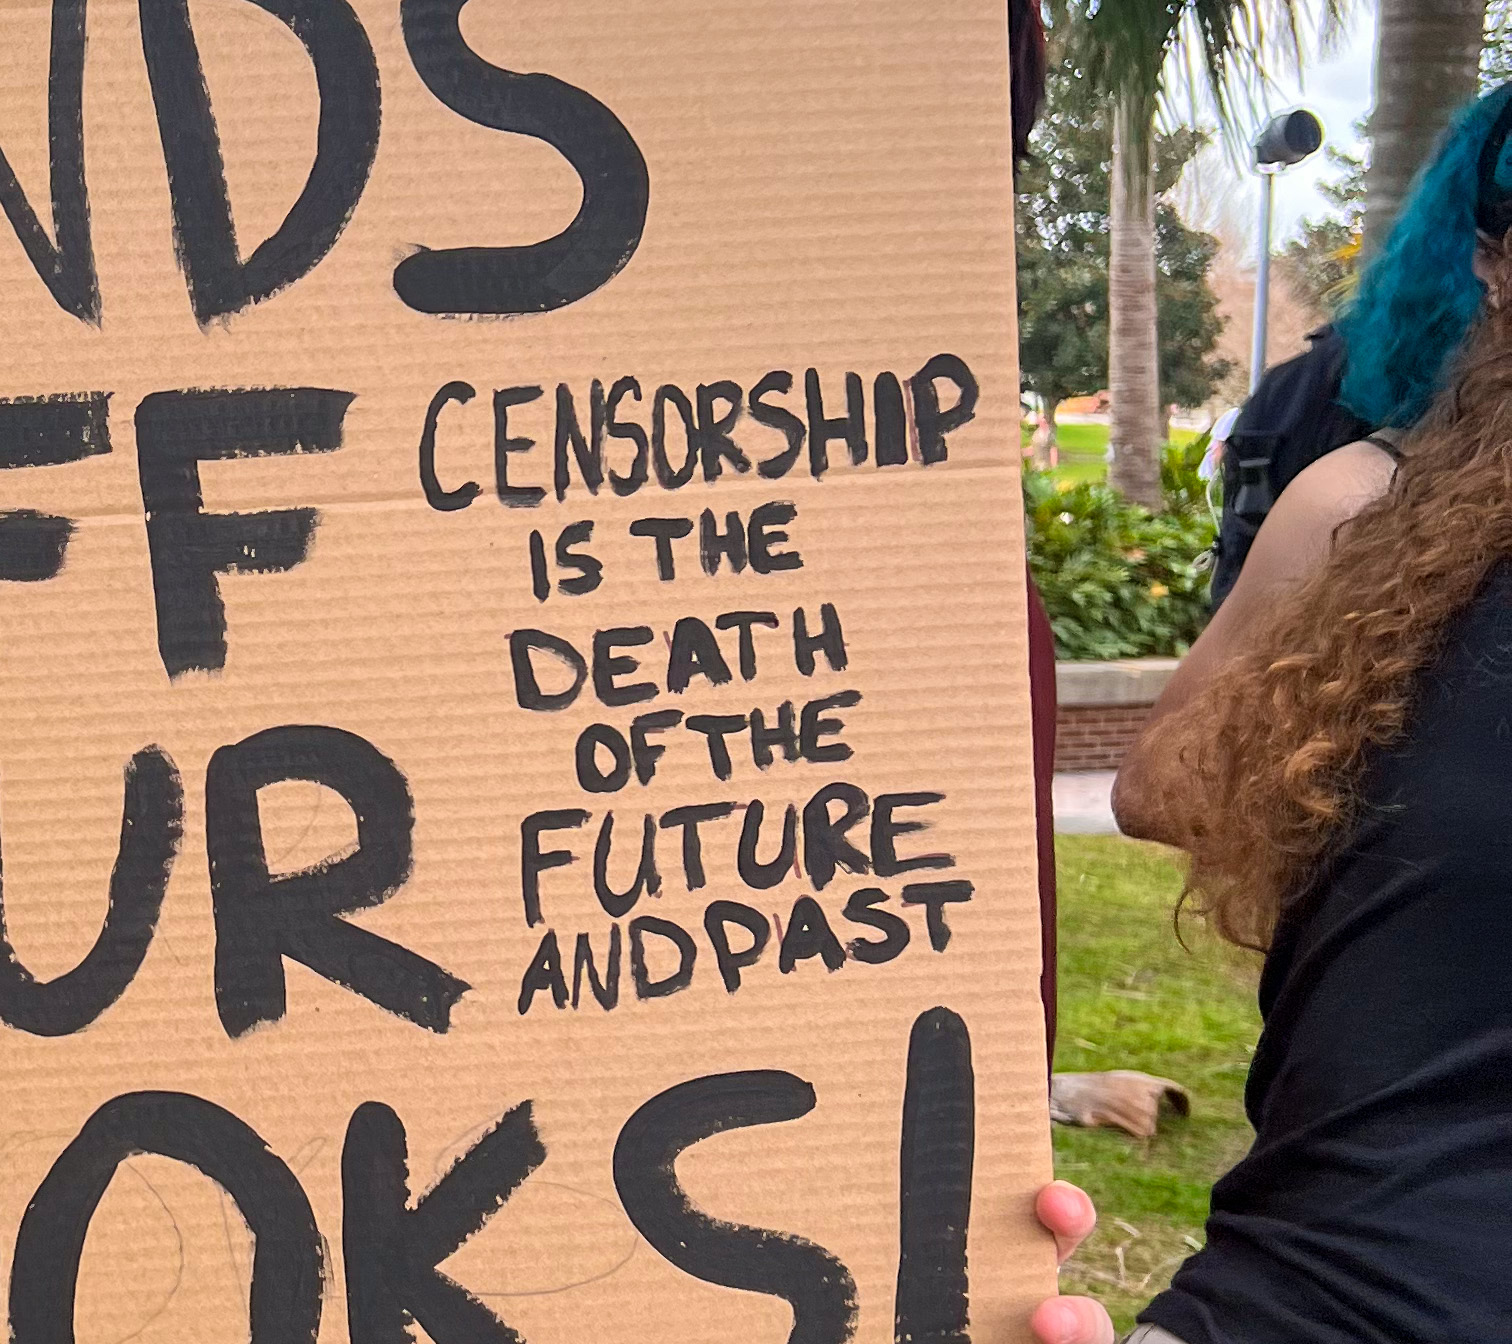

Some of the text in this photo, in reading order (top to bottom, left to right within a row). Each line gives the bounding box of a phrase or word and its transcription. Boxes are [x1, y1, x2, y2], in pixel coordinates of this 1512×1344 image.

[419, 353, 979, 512] CENSORSHIP
[529, 501, 804, 602] IS THE
[506, 603, 849, 712] DEATH
[520, 783, 956, 928] FUTURE
